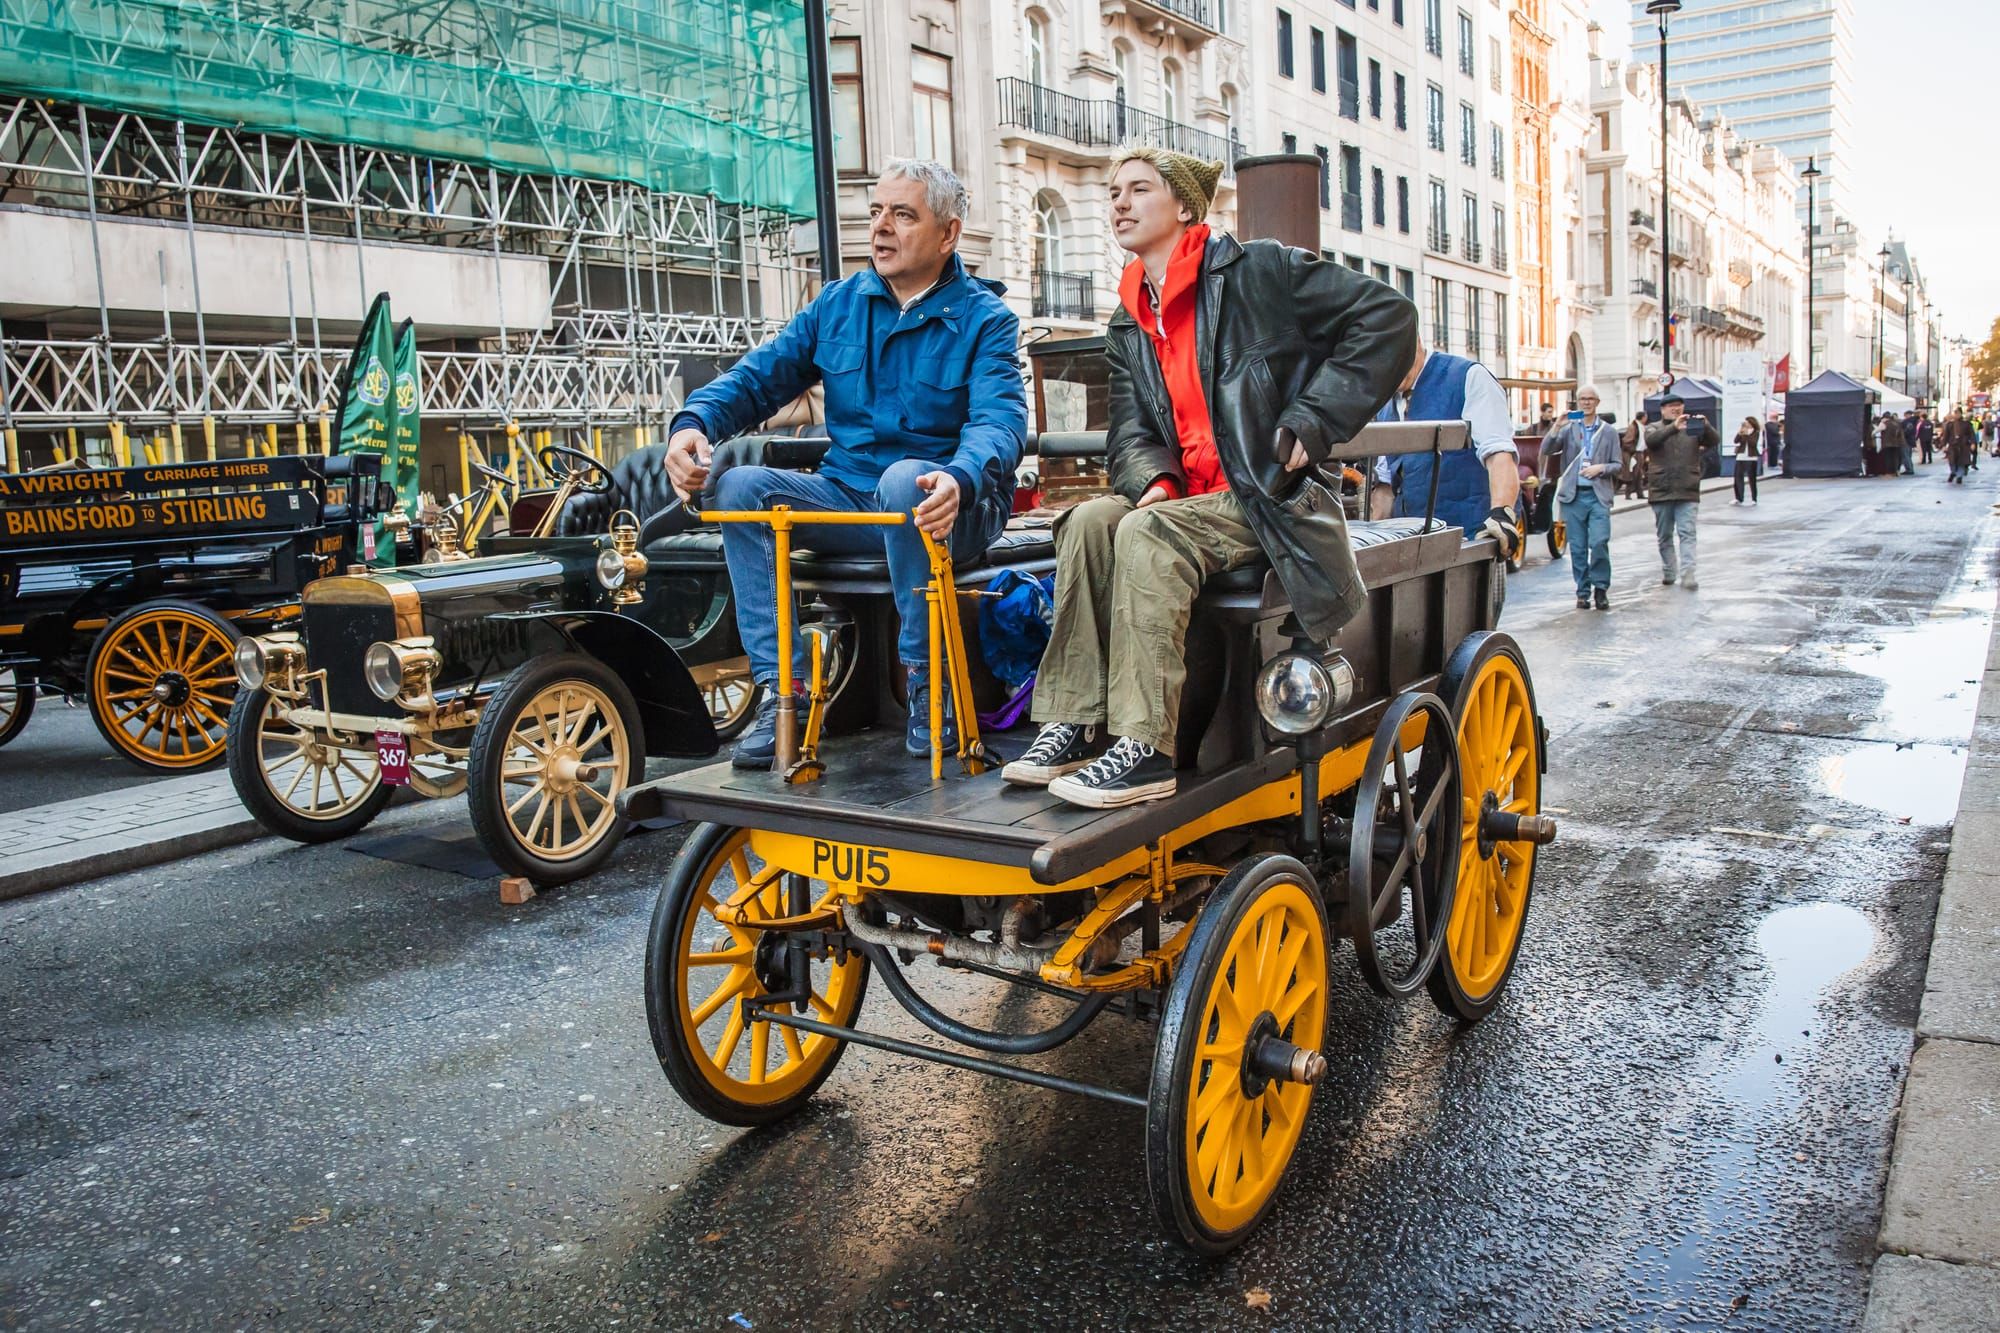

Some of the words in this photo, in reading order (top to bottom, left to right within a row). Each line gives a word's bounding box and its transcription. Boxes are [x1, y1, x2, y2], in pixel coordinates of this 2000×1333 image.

[366, 418, 385, 432] The
[19, 471, 125, 494] WRIGHT
[144, 466, 219, 482] CARRIAGE
[224, 463, 270, 477] HIRER
[5, 504, 135, 535] BAINSFORD
[142, 507, 156, 520] TO
[161, 495, 267, 525] STIRLING
[379, 748, 406, 767] 367
[813, 840, 891, 887] PU15
